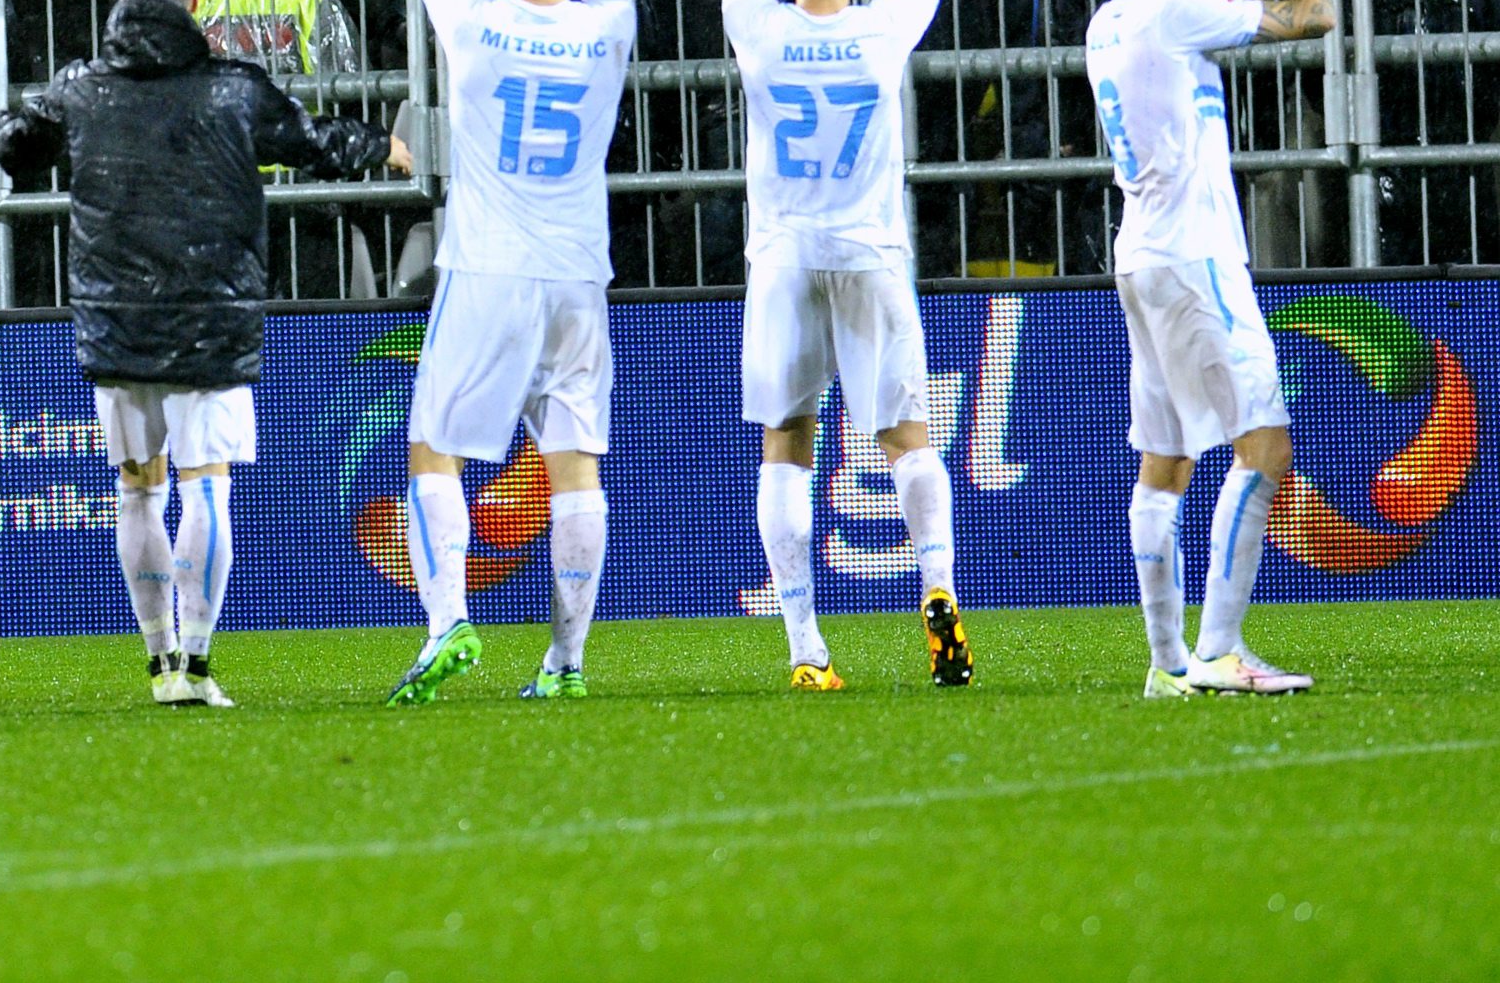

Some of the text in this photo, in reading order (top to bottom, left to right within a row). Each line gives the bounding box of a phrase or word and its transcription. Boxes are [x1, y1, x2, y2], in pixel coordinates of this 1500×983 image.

[783, 39, 862, 62] MIŠIĆ
[491, 76, 591, 178] 15
[767, 84, 880, 179] 27
